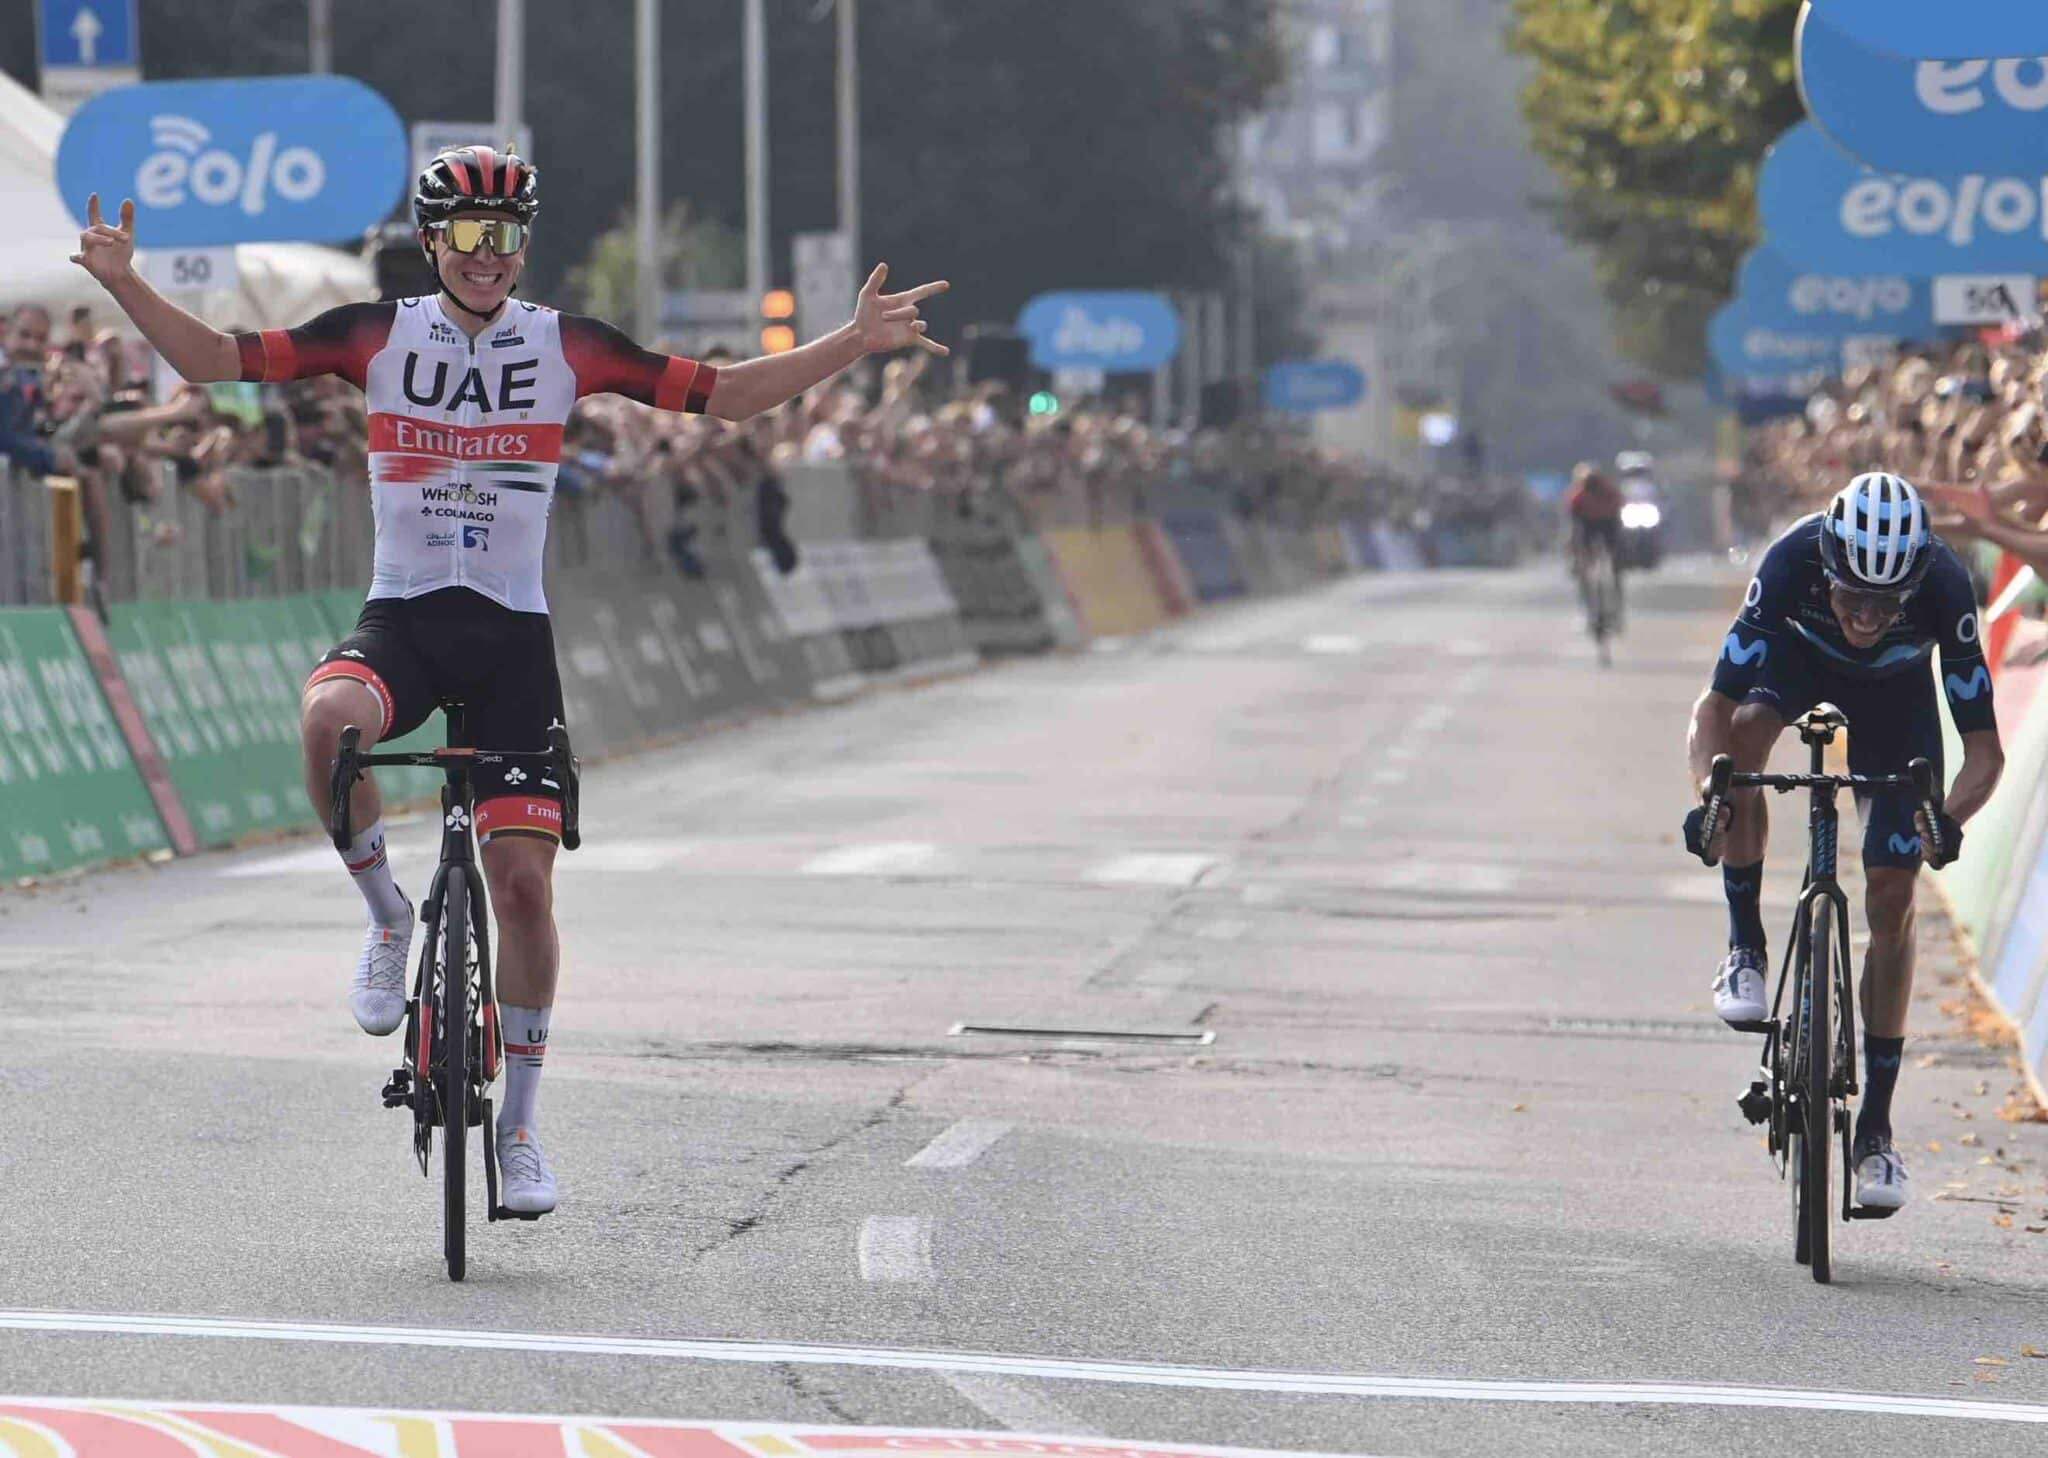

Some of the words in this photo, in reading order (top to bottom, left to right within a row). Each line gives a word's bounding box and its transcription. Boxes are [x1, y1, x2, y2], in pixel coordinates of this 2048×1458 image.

[136, 130, 325, 215] eolo
[1841, 173, 2036, 246] eolo
[173, 254, 213, 284] 50
[402, 351, 539, 413] UAE
[396, 420, 528, 456] Emirates
[434, 507, 495, 522] COLNAGO
